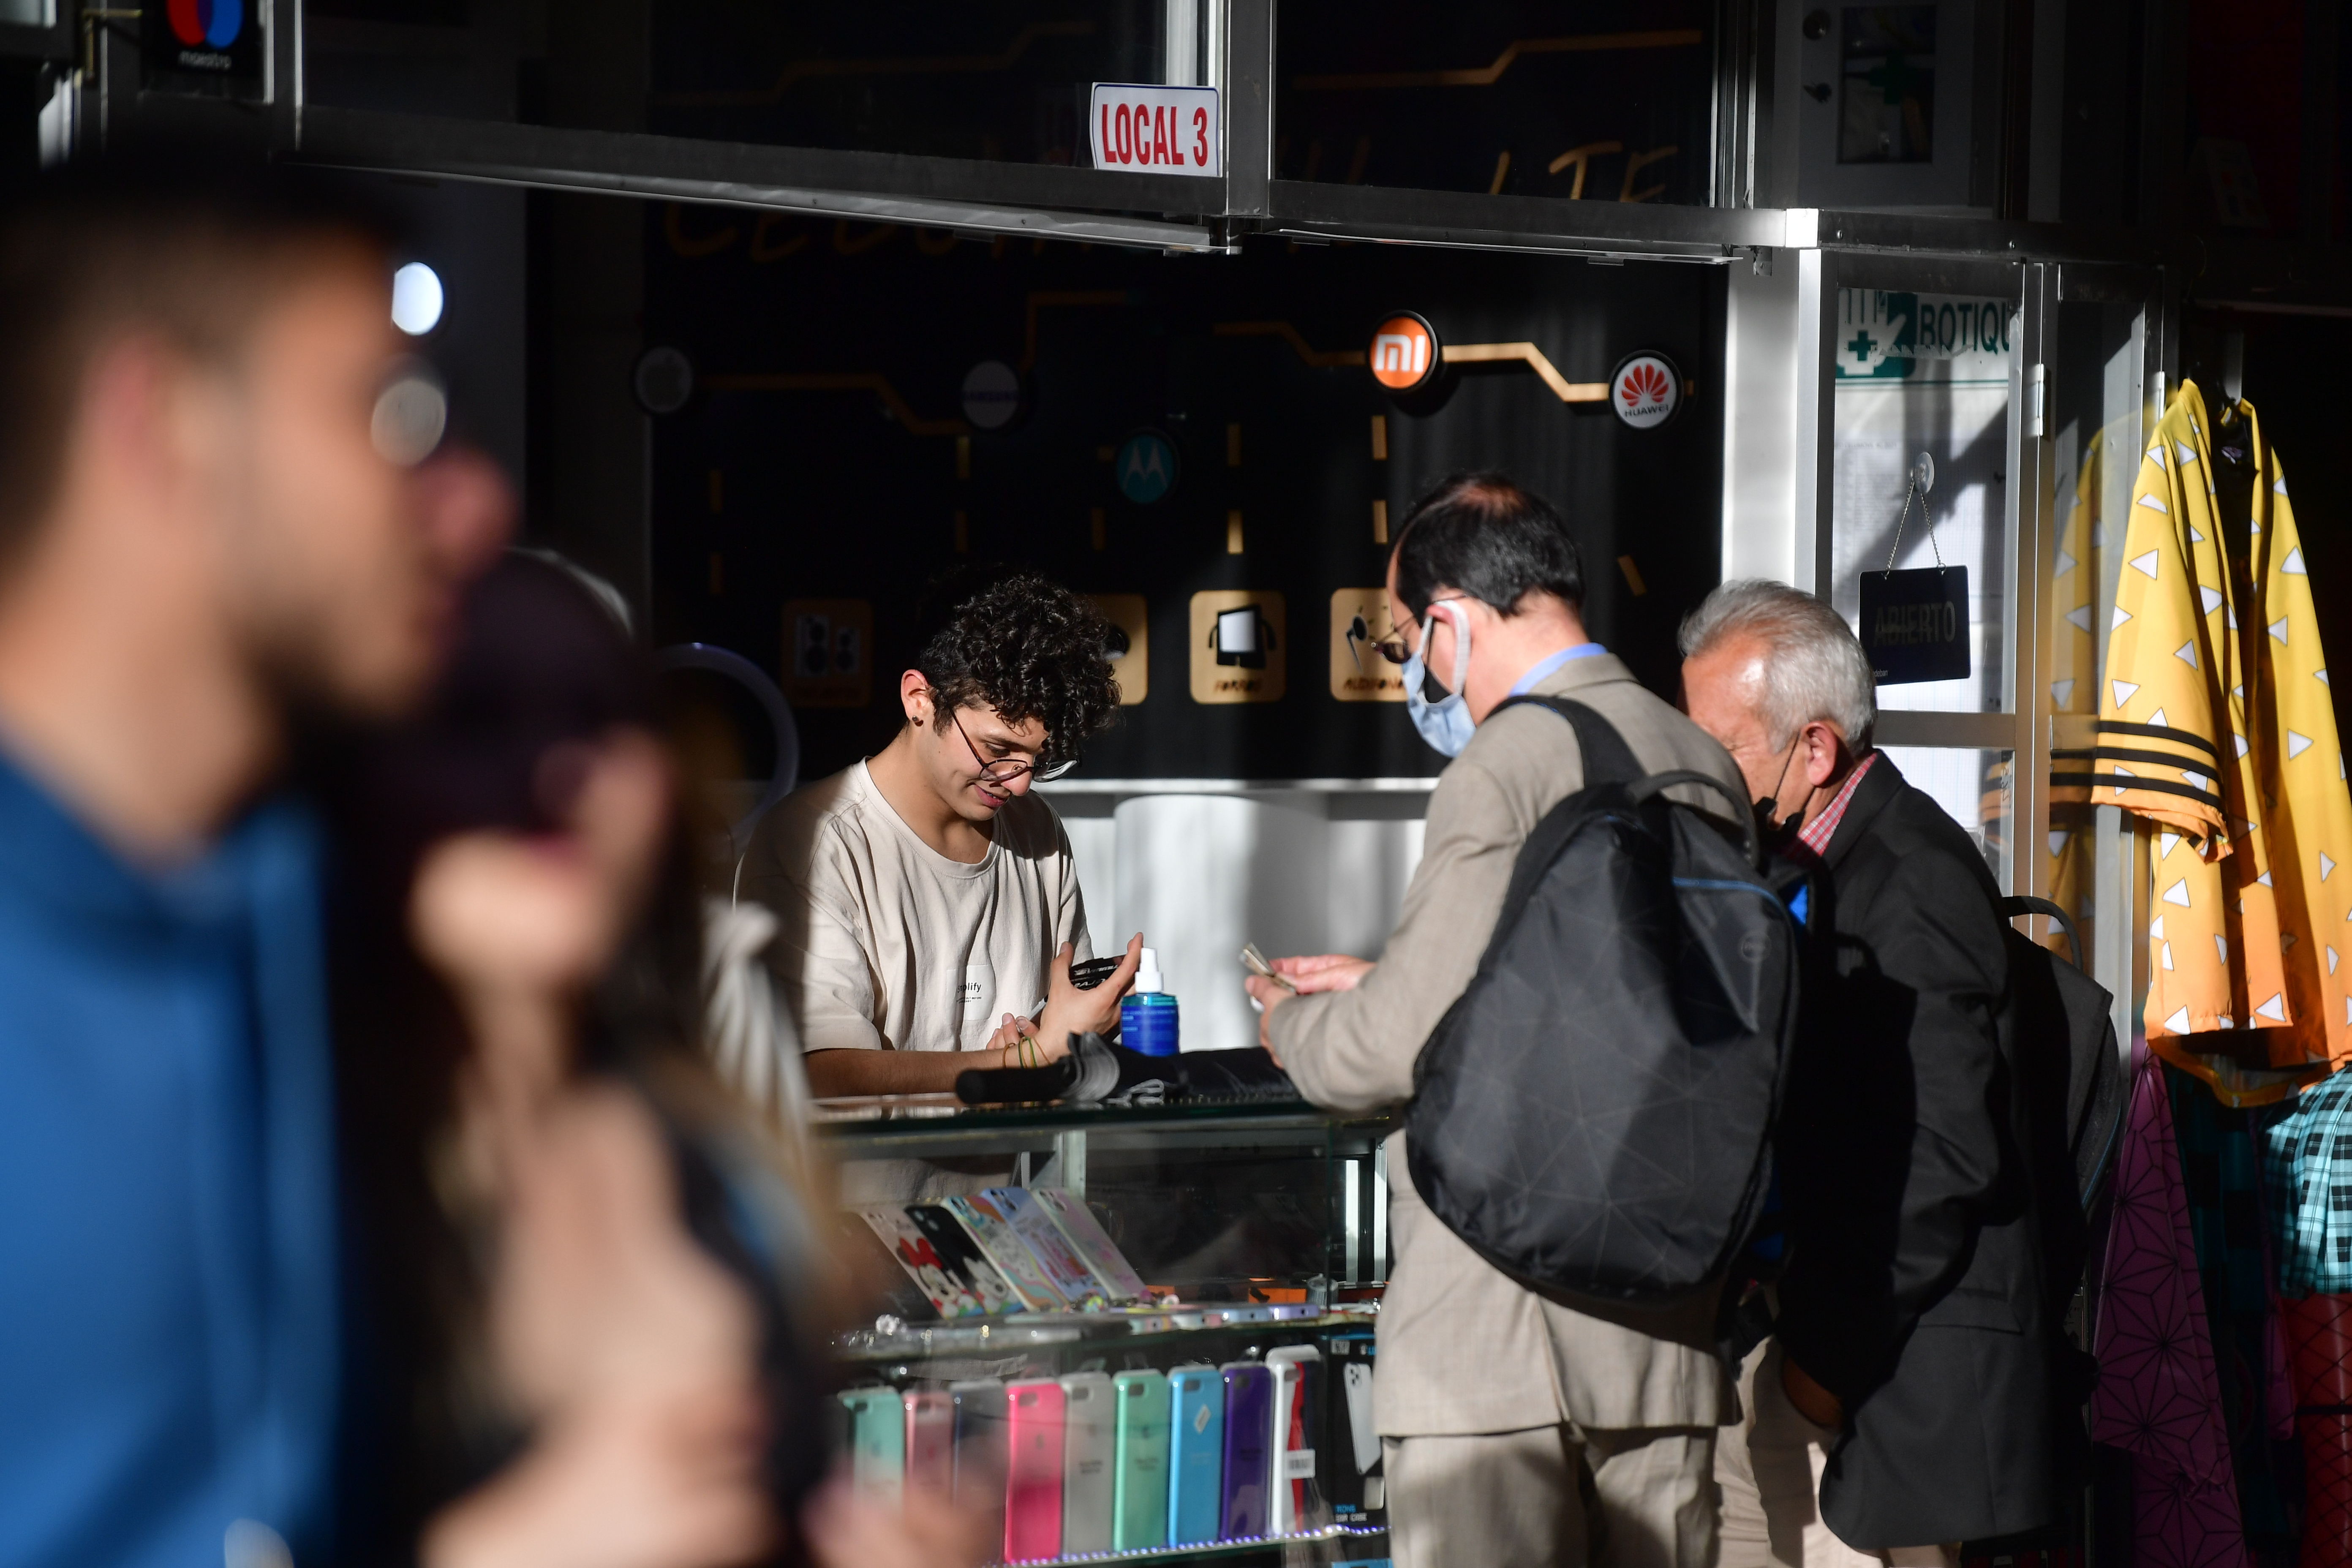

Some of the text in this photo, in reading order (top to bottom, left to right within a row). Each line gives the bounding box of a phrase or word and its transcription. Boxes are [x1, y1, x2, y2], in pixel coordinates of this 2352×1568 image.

[179, 50, 231, 71] maestro
[1102, 103, 1208, 166] LOCAL 3
[1625, 404, 1669, 416] HUAWEI
[1873, 601, 1956, 647] ABIERTO
